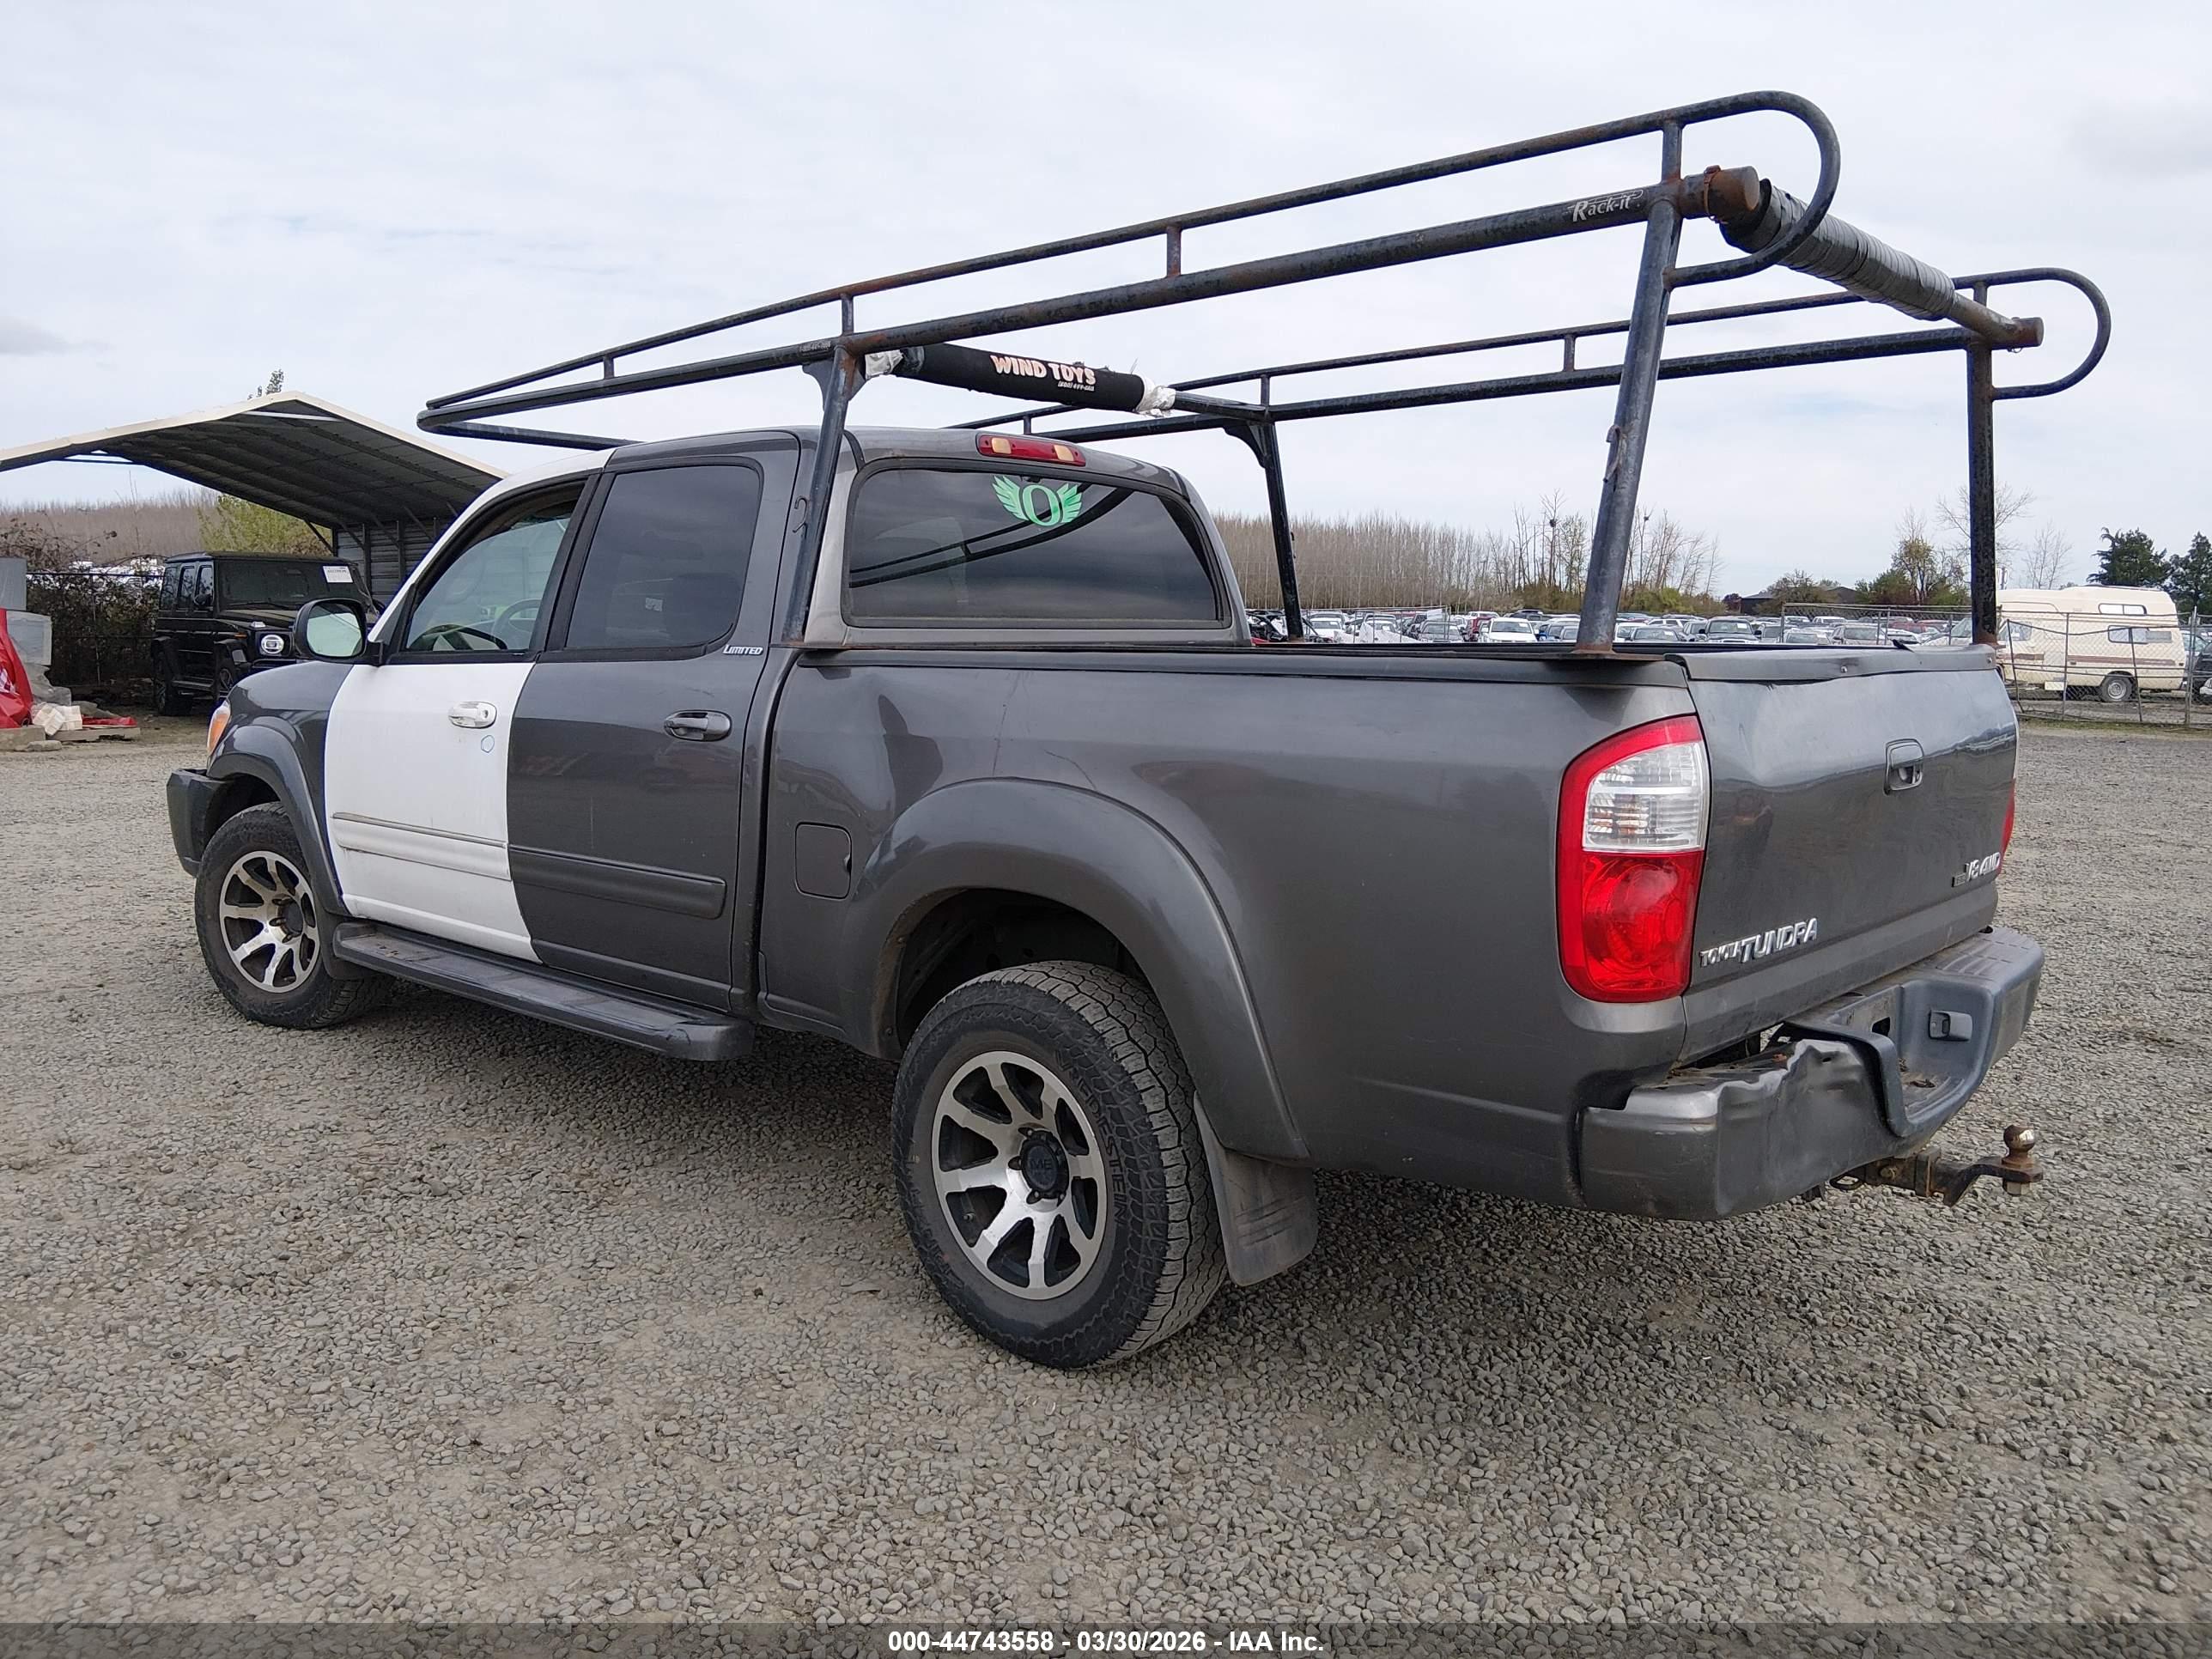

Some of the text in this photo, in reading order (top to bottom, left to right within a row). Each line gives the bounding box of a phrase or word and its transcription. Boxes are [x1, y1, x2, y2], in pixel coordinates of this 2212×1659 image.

[1572, 195, 1632, 222] Rack-it
[990, 355, 1097, 386] WIND TOYS
[722, 643, 763, 655] LIMITED
[1741, 917, 1818, 963] TUNDRA
